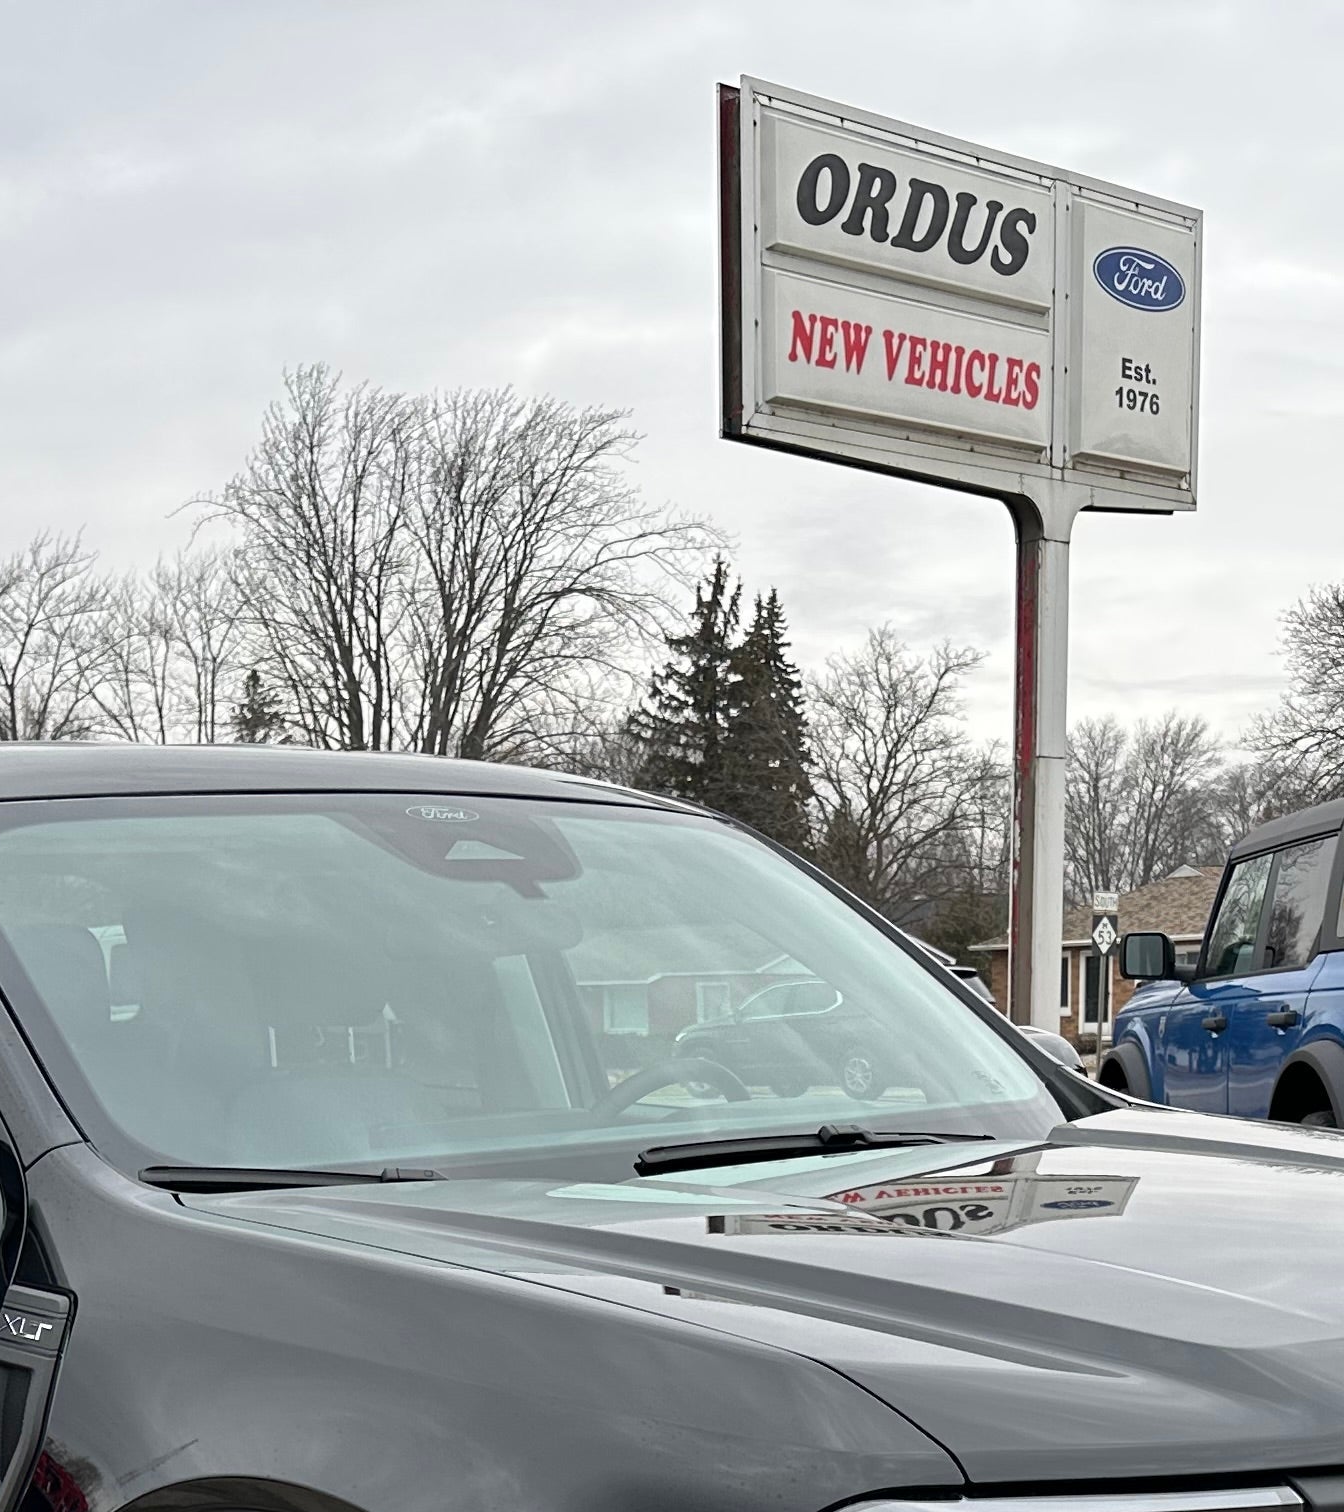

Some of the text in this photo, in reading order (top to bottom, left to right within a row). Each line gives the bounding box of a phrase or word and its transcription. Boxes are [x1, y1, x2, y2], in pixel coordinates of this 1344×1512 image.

[797, 153, 1036, 276] ORDUS
[1113, 255, 1168, 302] Ford
[788, 310, 1042, 411] NEW VEHICLES
[1120, 356, 1157, 386] Est.
[1114, 386, 1161, 416] 1976
[420, 807, 468, 820] Ford
[1097, 930, 1112, 945] 53
